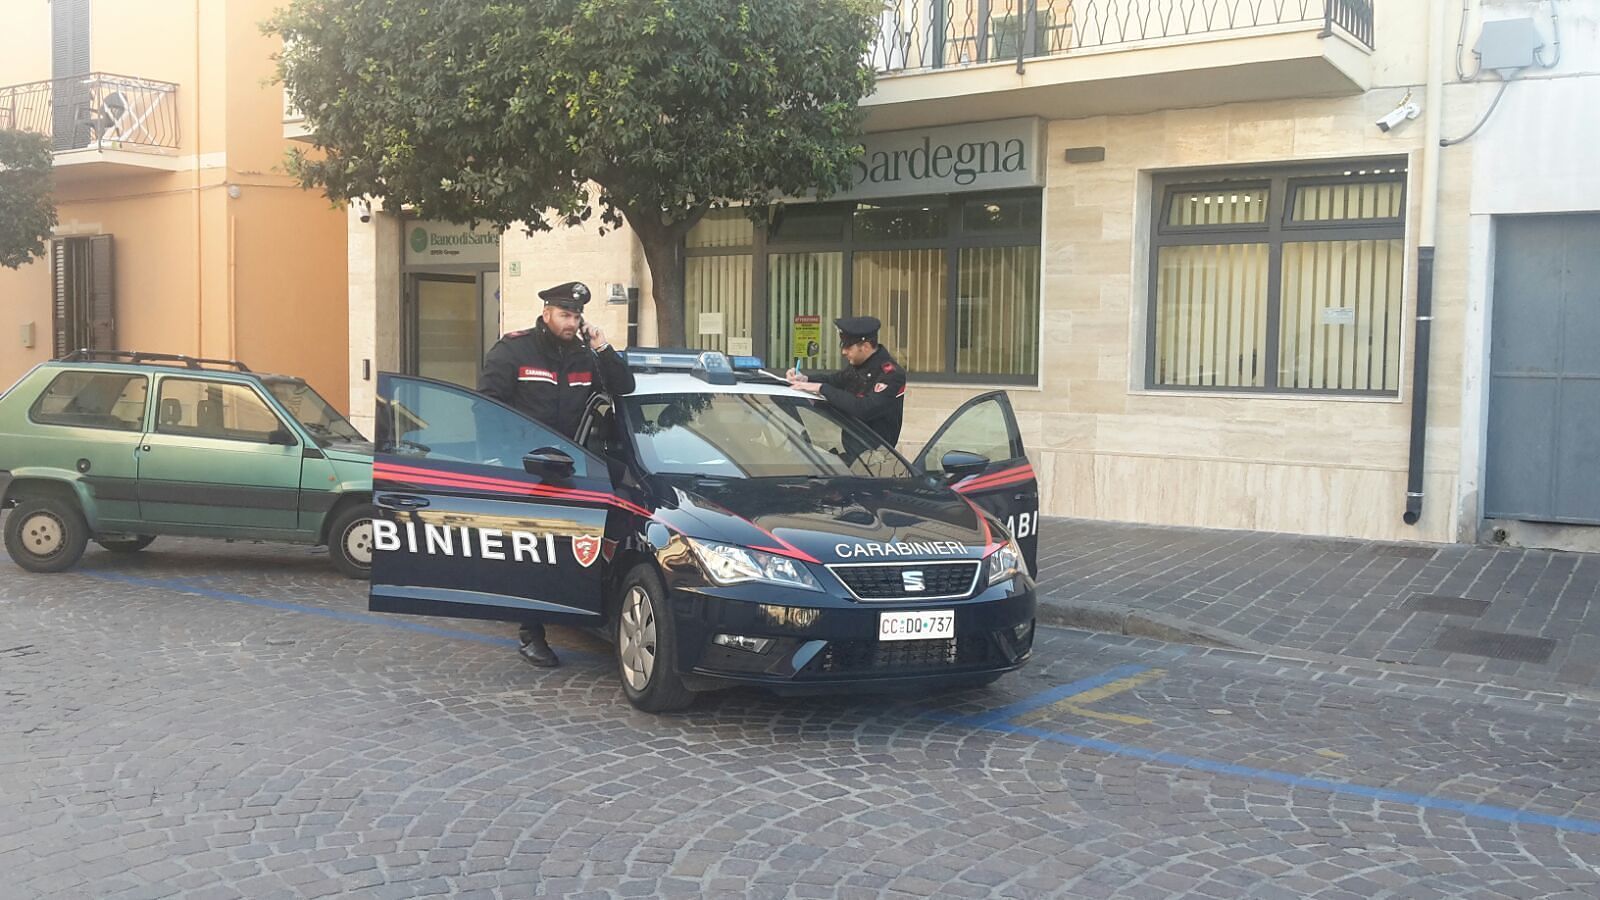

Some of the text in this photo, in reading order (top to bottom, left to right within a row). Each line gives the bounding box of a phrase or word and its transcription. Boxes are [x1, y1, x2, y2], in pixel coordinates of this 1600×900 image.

[998, 510, 1038, 539] ABI
[372, 519, 557, 565] BINIERI
[835, 541, 969, 558] CARABINIERI
